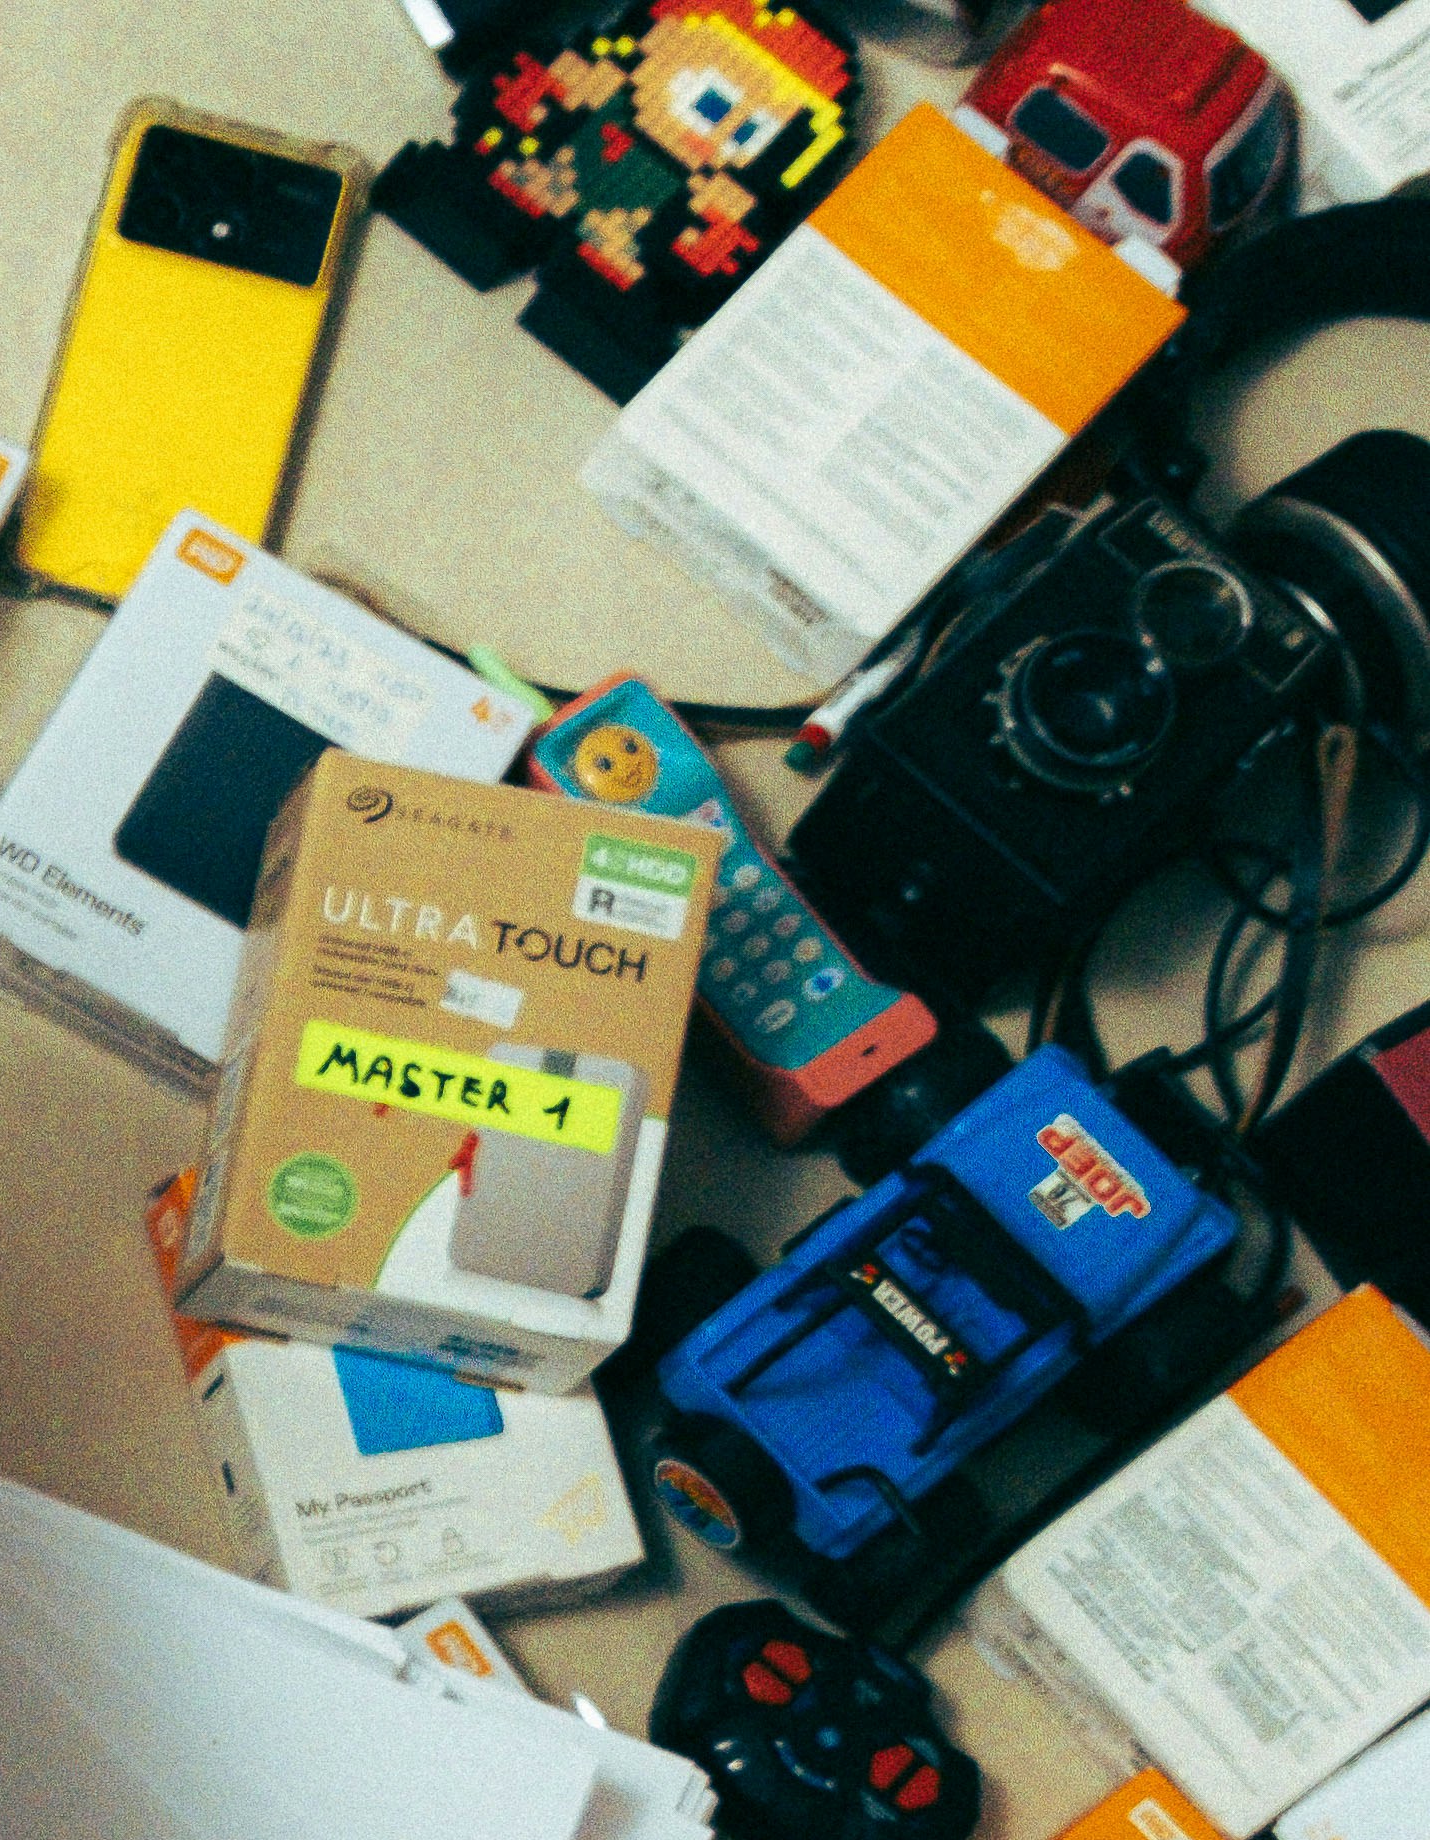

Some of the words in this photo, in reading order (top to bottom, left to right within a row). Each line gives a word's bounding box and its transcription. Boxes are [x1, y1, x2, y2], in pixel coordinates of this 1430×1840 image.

[42, 865, 144, 935] Elements
[324, 887, 478, 949] ULTRA
[493, 920, 647, 983] TOUCH
[318, 1044, 509, 1113] MASTER
[544, 1097, 570, 1129] 1
[873, 1281, 948, 1354] POWER
[296, 1499, 329, 1517] My
[335, 1480, 432, 1511] Passport
